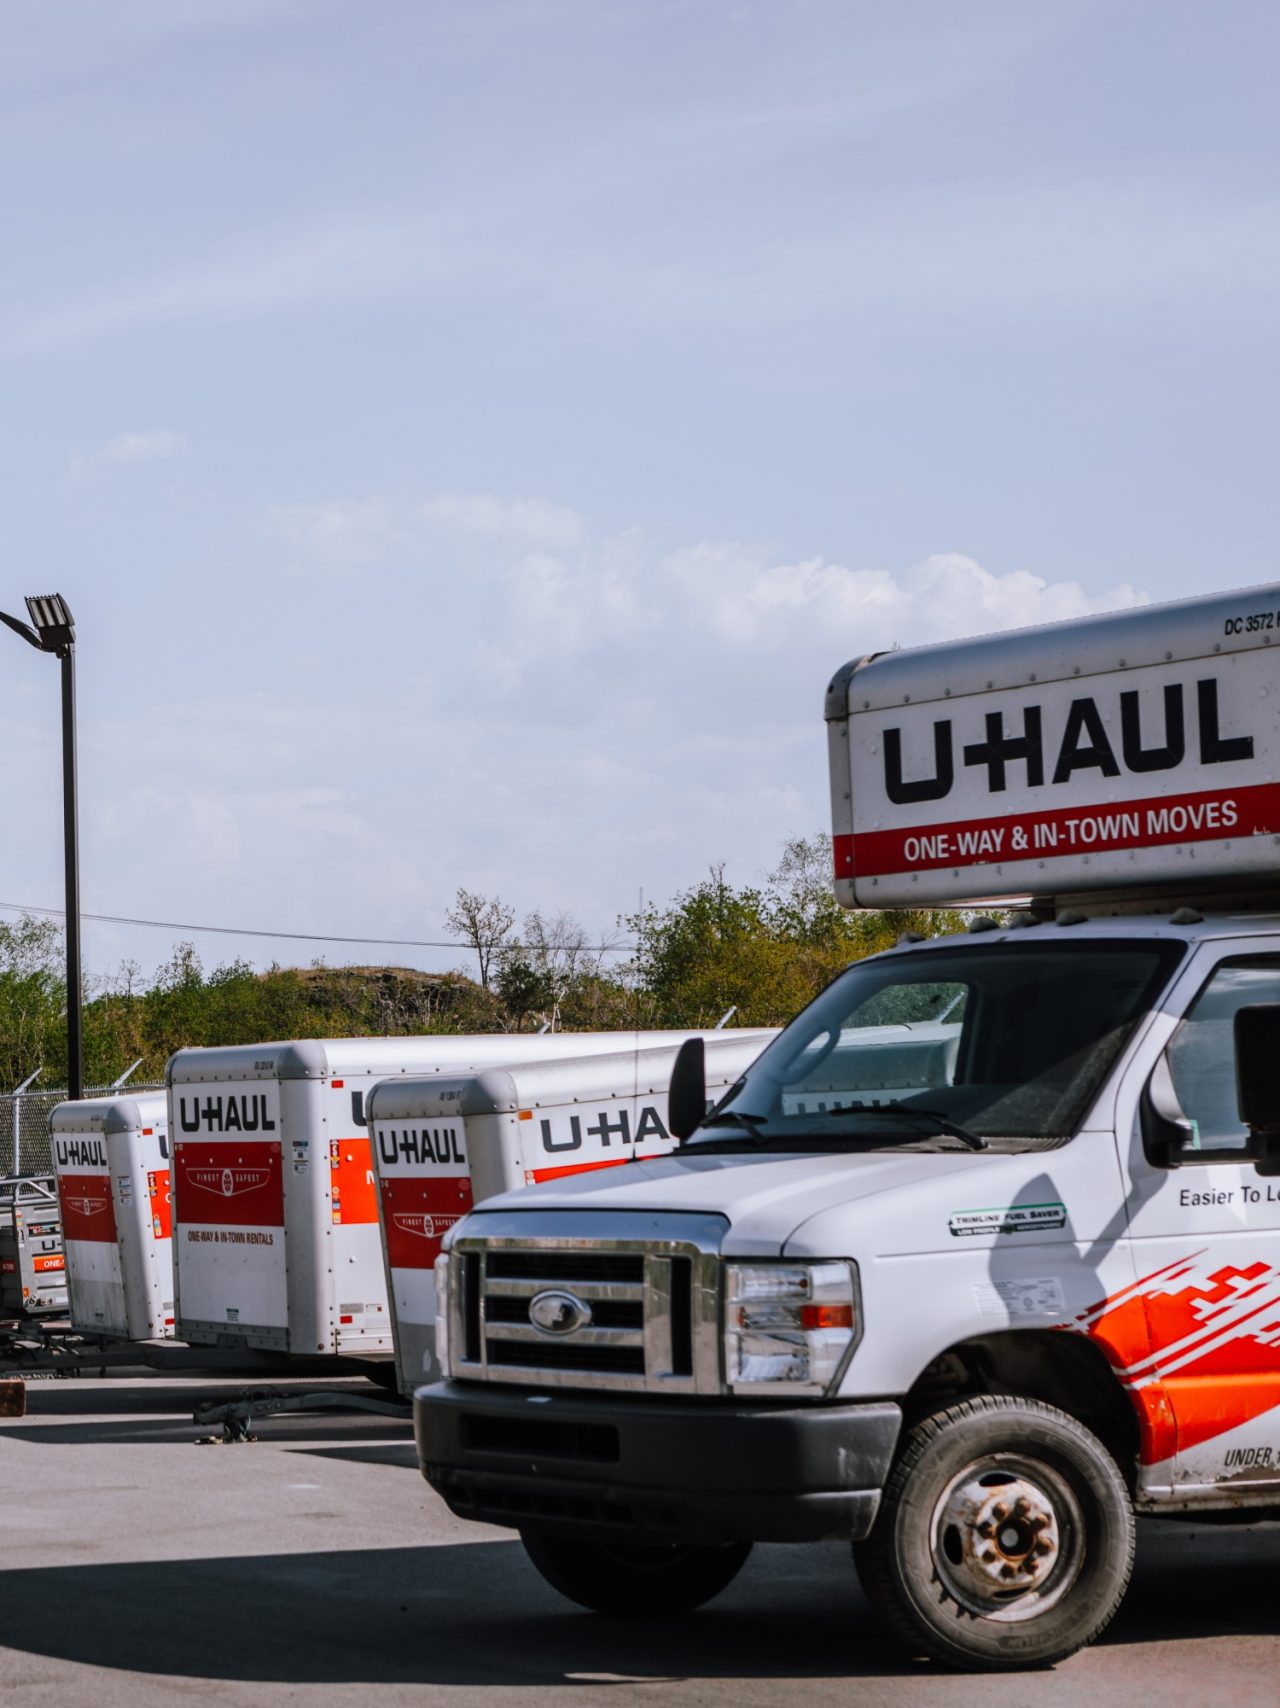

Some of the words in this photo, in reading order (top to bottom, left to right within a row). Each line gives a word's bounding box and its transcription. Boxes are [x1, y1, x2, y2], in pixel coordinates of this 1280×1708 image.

[1224, 617, 1243, 636] DC
[1246, 612, 1274, 632] 3572
[882, 678, 1254, 805] U-HAUL
[904, 827, 1005, 861] ONE-WAY
[1011, 825, 1028, 851] &
[1033, 812, 1140, 848] IN-TOWN
[1146, 799, 1238, 835] MOVES
[180, 1094, 275, 1132] U-HAUL
[56, 1141, 107, 1166] U-HAUL
[379, 1129, 465, 1164] U-HAUL
[1180, 1188, 1234, 1206] Easier
[1240, 1186, 1261, 1204] To
[1267, 1185, 1280, 1202] L
[956, 1214, 1000, 1224] TRIMLINE
[1005, 1212, 1026, 1220] FUEL
[1030, 1209, 1060, 1219] SAVER
[187, 1230, 214, 1242] ONE-WAY
[220, 1231, 246, 1244] IN-TOWN
[246, 1232, 274, 1245] RENTALS
[43, 1259, 64, 1269] ONE-
[1224, 1446, 1272, 1467] UNDER
